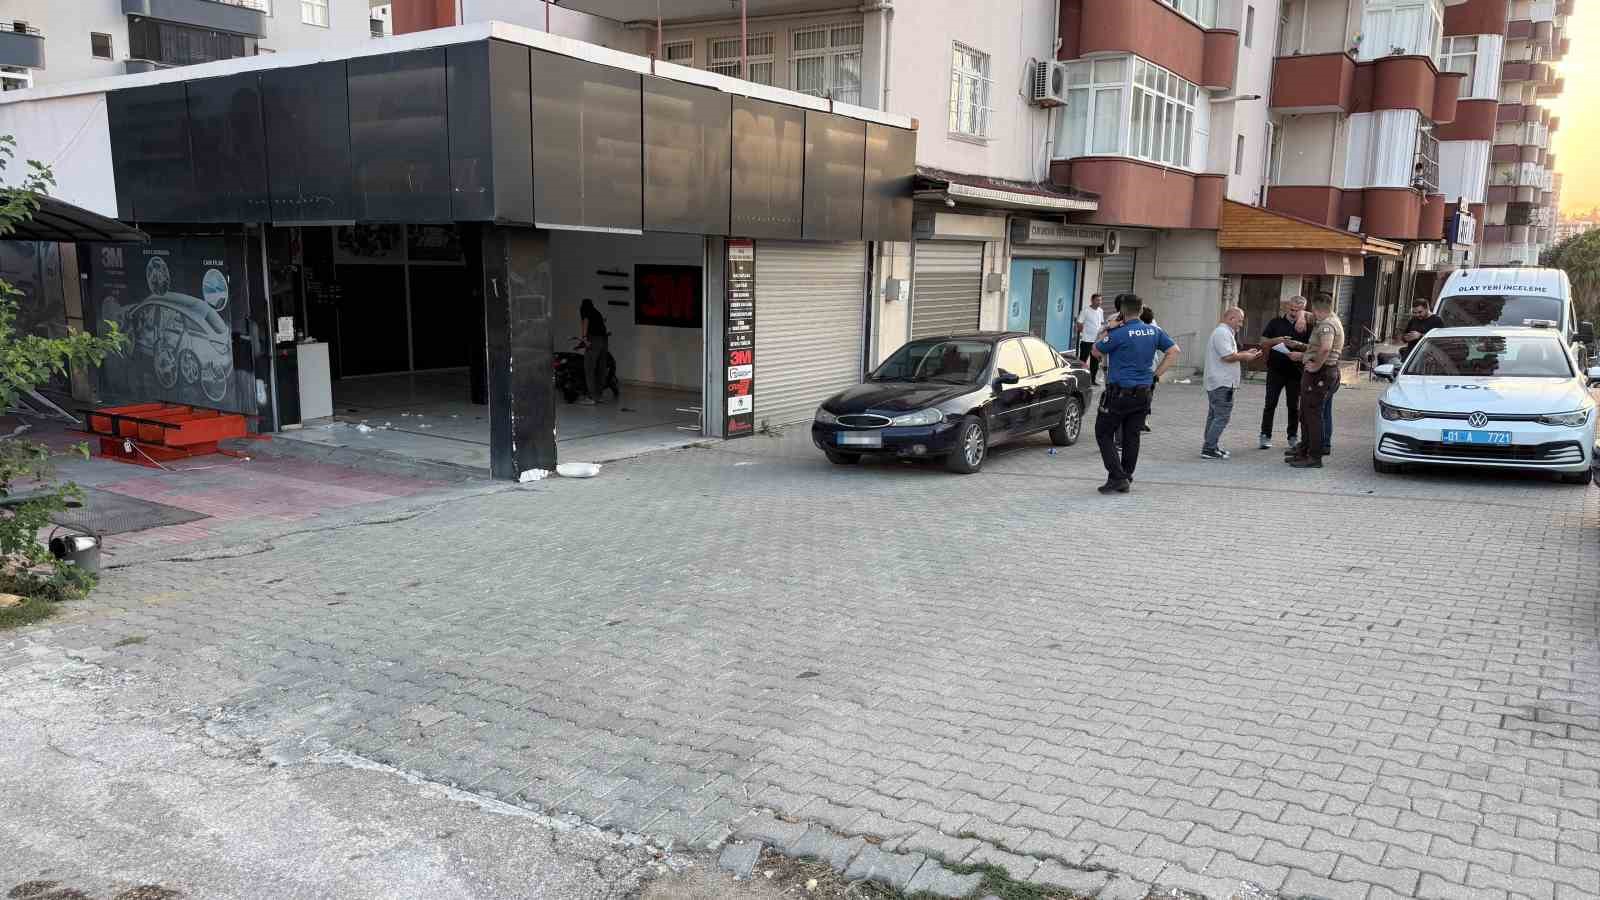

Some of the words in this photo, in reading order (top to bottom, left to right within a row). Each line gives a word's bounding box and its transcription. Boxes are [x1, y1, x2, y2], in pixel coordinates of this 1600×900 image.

[102, 247, 122, 267] 3M
[640, 273, 693, 318] 3M
[730, 351, 752, 365] 3M
[1448, 431, 1458, 441] 01
[1466, 431, 1473, 442] A
[1488, 431, 1510, 443] 7721
